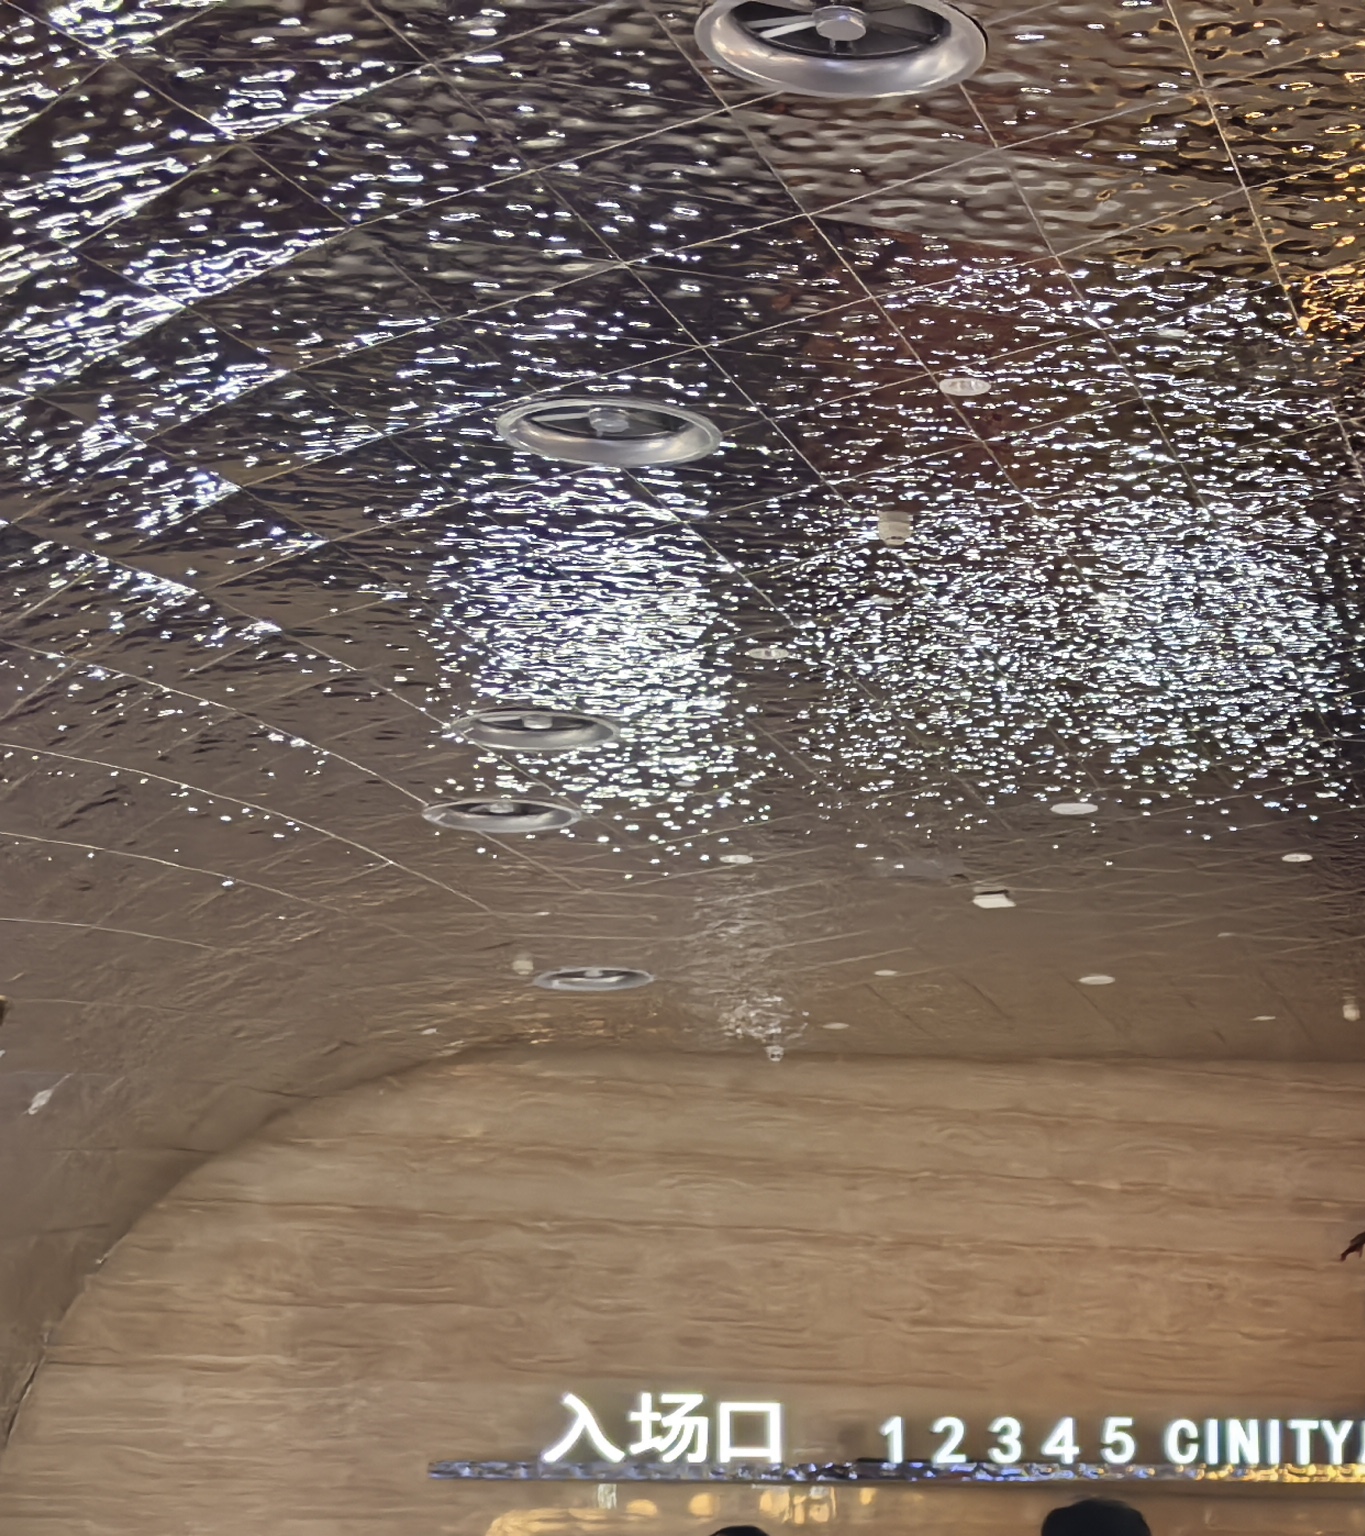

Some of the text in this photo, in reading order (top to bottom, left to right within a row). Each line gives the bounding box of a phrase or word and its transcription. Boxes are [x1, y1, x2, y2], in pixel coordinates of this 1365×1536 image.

[542, 1391, 783, 1464] 入场口
[880, 1416, 904, 1464] 1
[931, 1416, 968, 1464] 2
[987, 1416, 1023, 1464] 3
[1041, 1416, 1080, 1465] 4
[1100, 1416, 1136, 1464] 5
